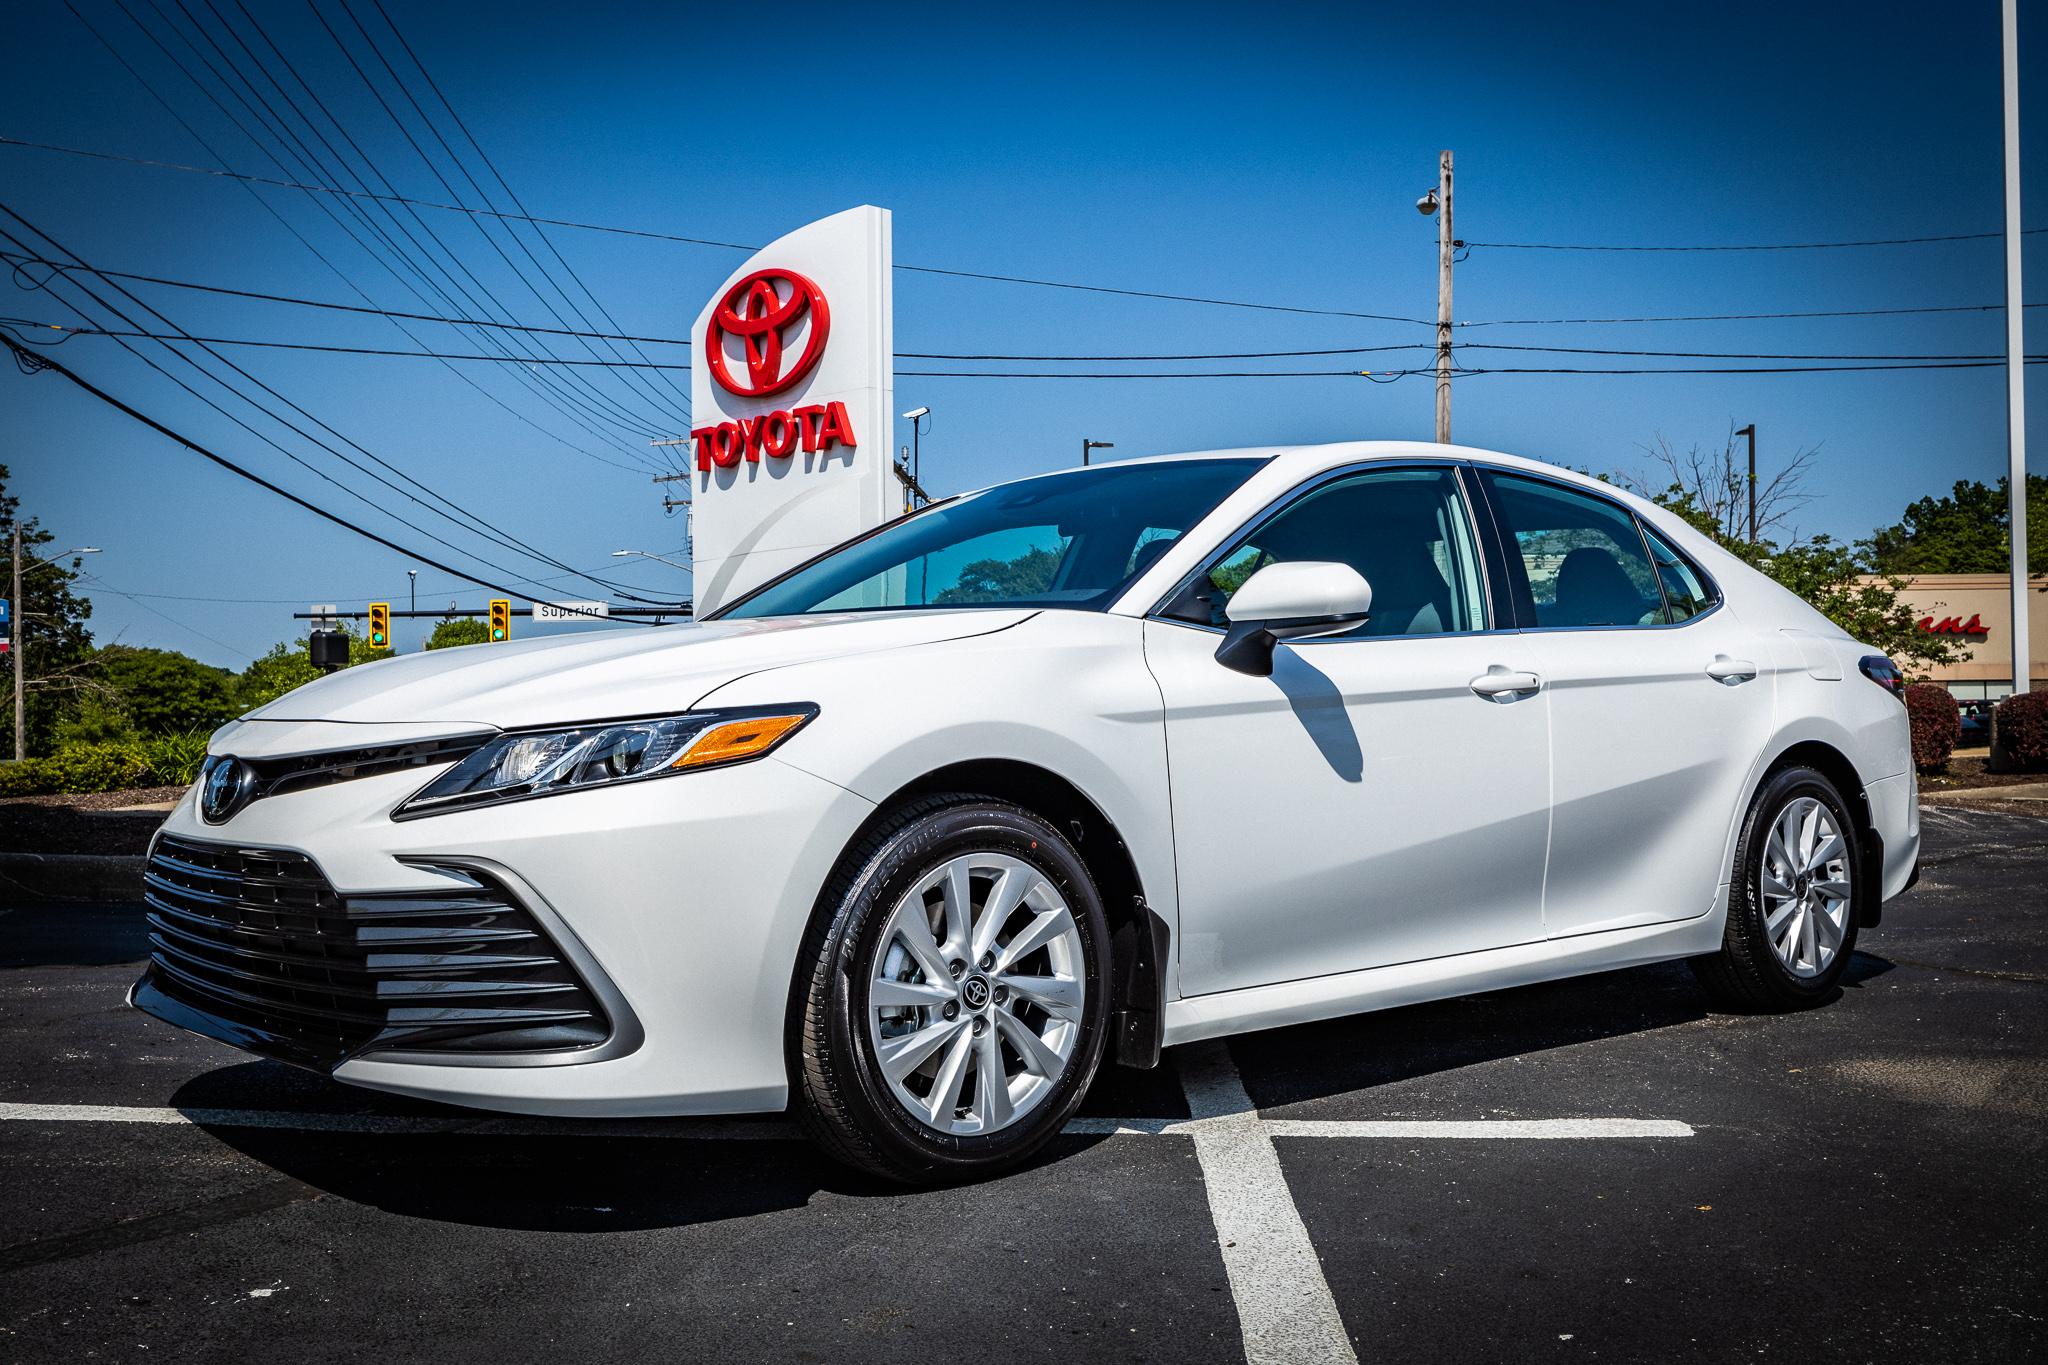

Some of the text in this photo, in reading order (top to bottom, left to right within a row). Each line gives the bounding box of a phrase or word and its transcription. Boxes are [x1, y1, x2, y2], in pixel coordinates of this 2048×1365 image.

[691, 401, 857, 471] TOYOTA
[541, 606, 599, 619] Superior
[1919, 613, 1991, 634] ens
